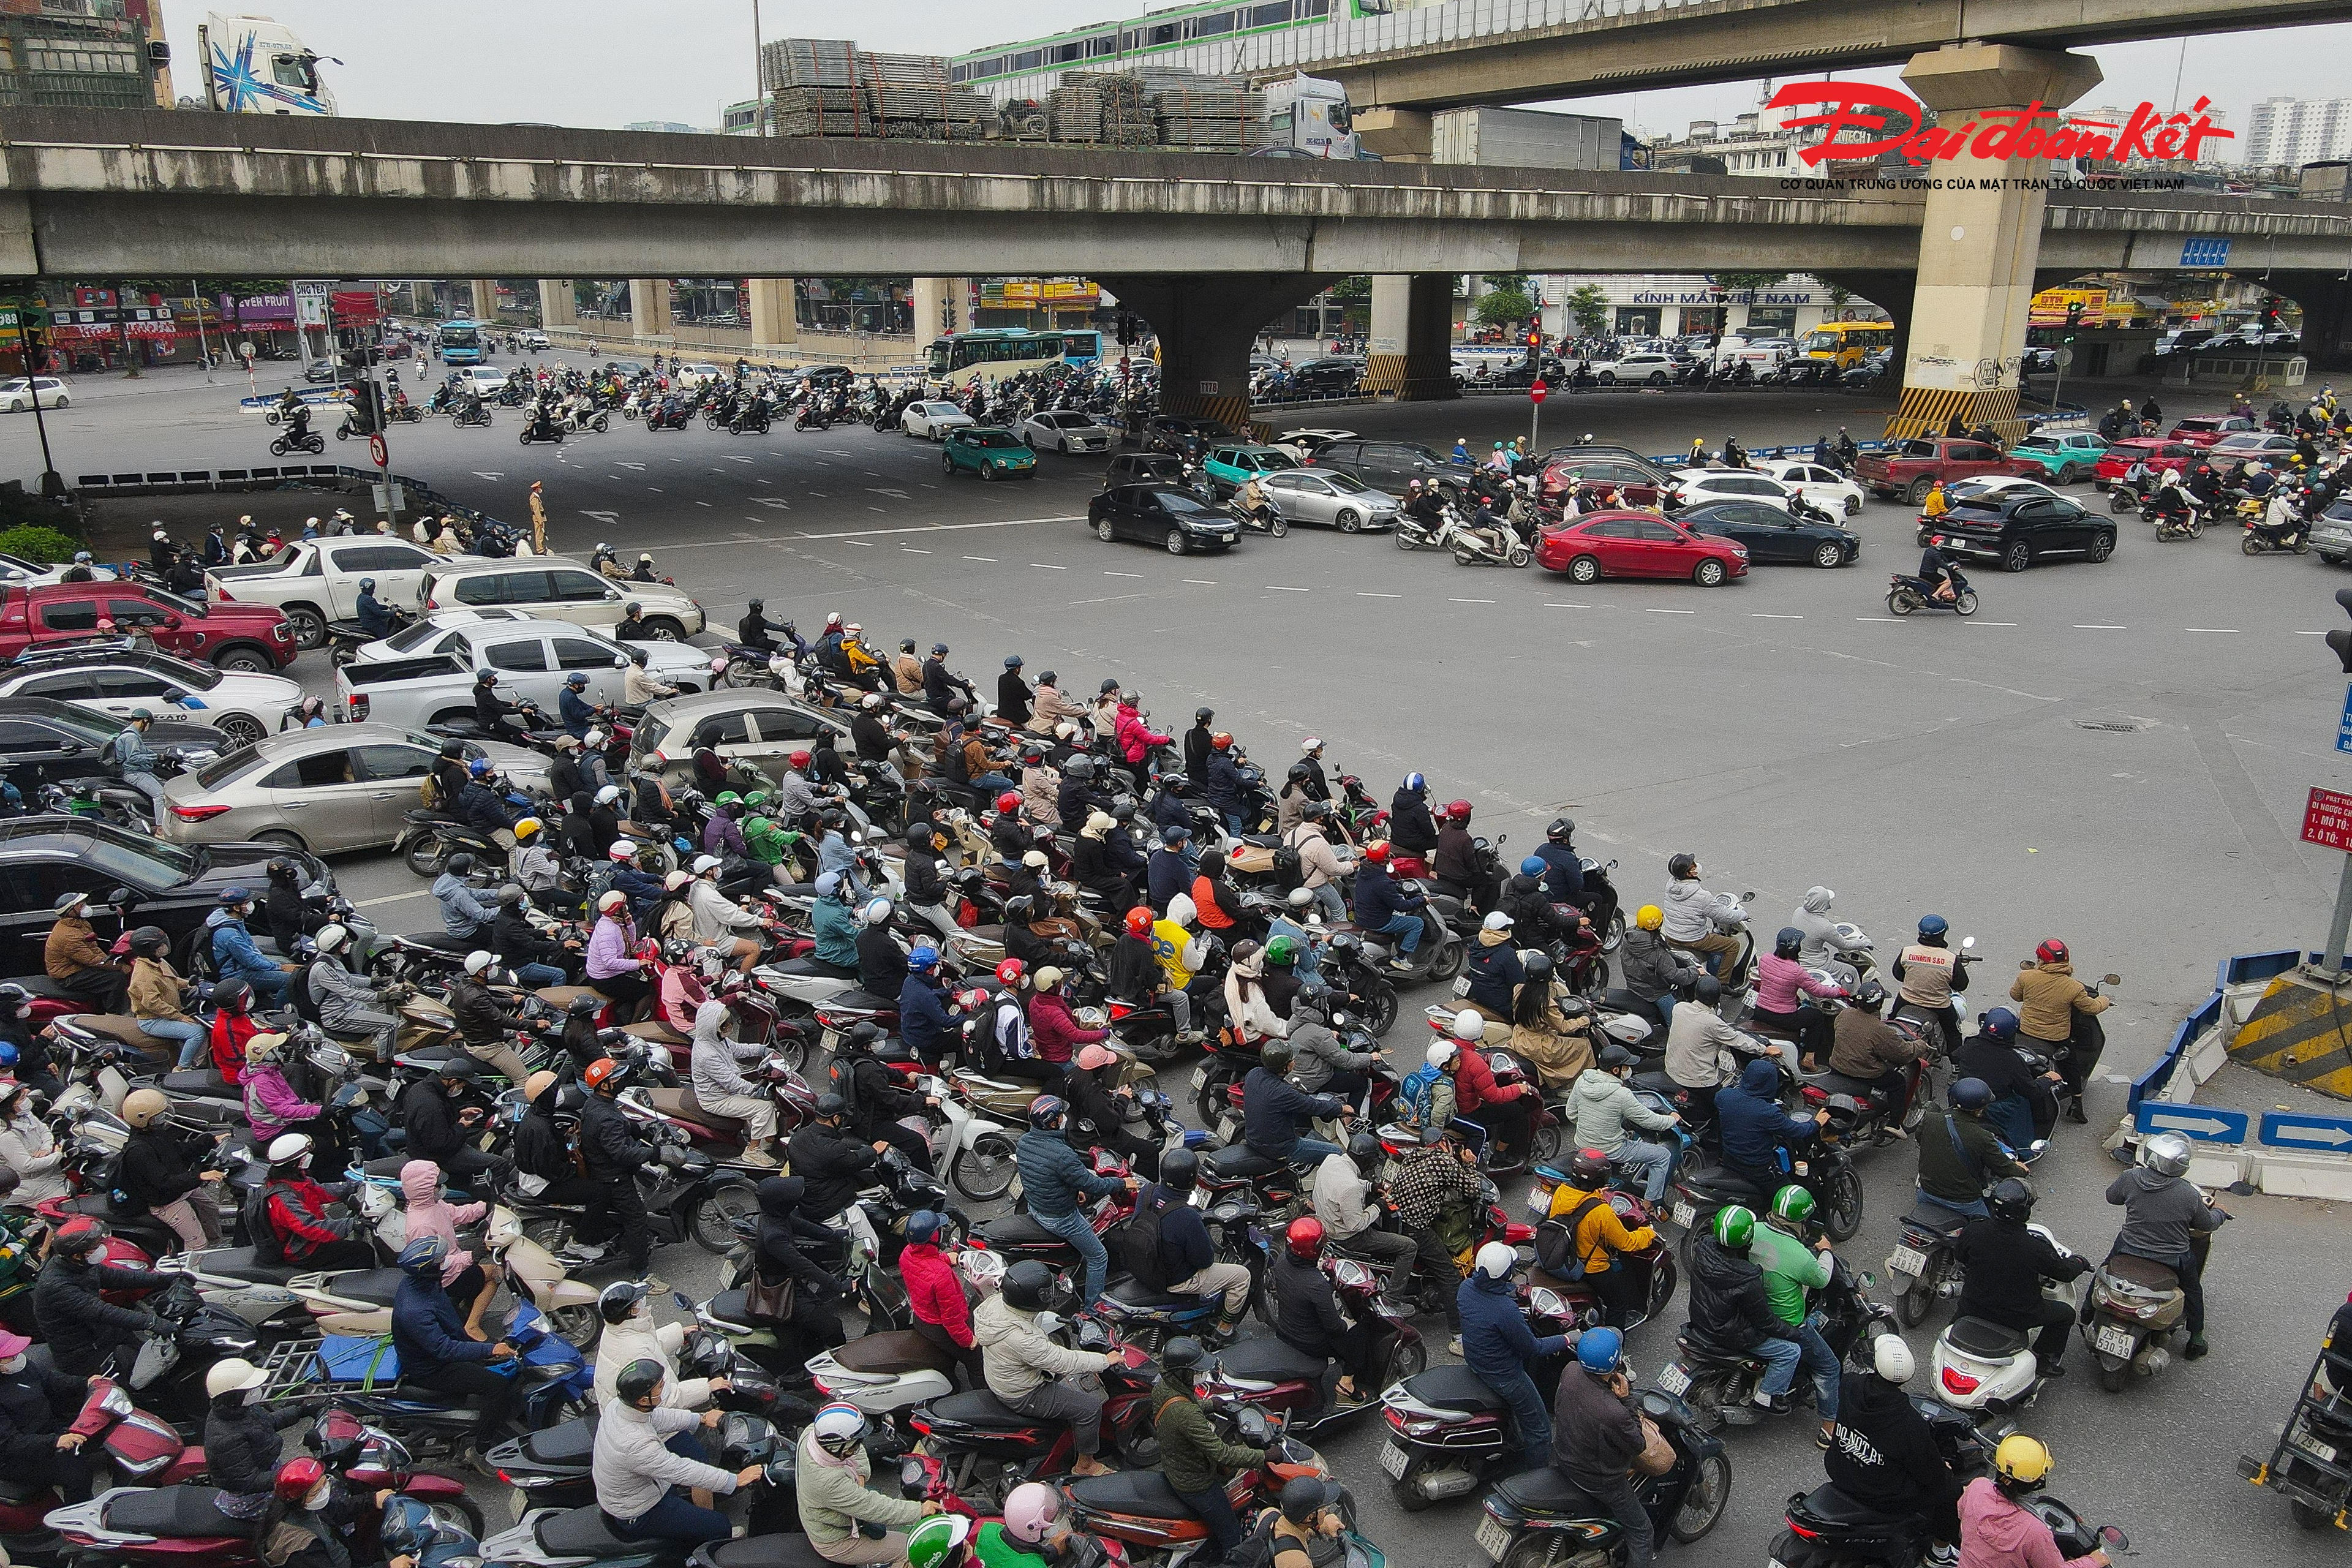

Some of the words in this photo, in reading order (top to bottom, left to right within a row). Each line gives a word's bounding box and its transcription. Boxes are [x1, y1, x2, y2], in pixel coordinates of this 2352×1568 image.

[1814, 128, 1866, 143] NAENTECH
[312, 285, 325, 295] TEA
[1634, 290, 1674, 303] KÍNH
[1765, 293, 1811, 304] NAM
[226, 296, 263, 307] KEVER
[265, 295, 290, 307] FRUIT
[2321, 815, 2334, 827] MÔ
[2318, 828, 2323, 840] Ô
[1894, 1256, 1918, 1274] 9812
[1836, 1422, 1847, 1440] DO
[1849, 1433, 1869, 1457] NOT
[1869, 1450, 1885, 1466] BE
[2301, 1434, 2332, 1460] 29-C1
[1479, 1530, 1501, 1556] 9391
